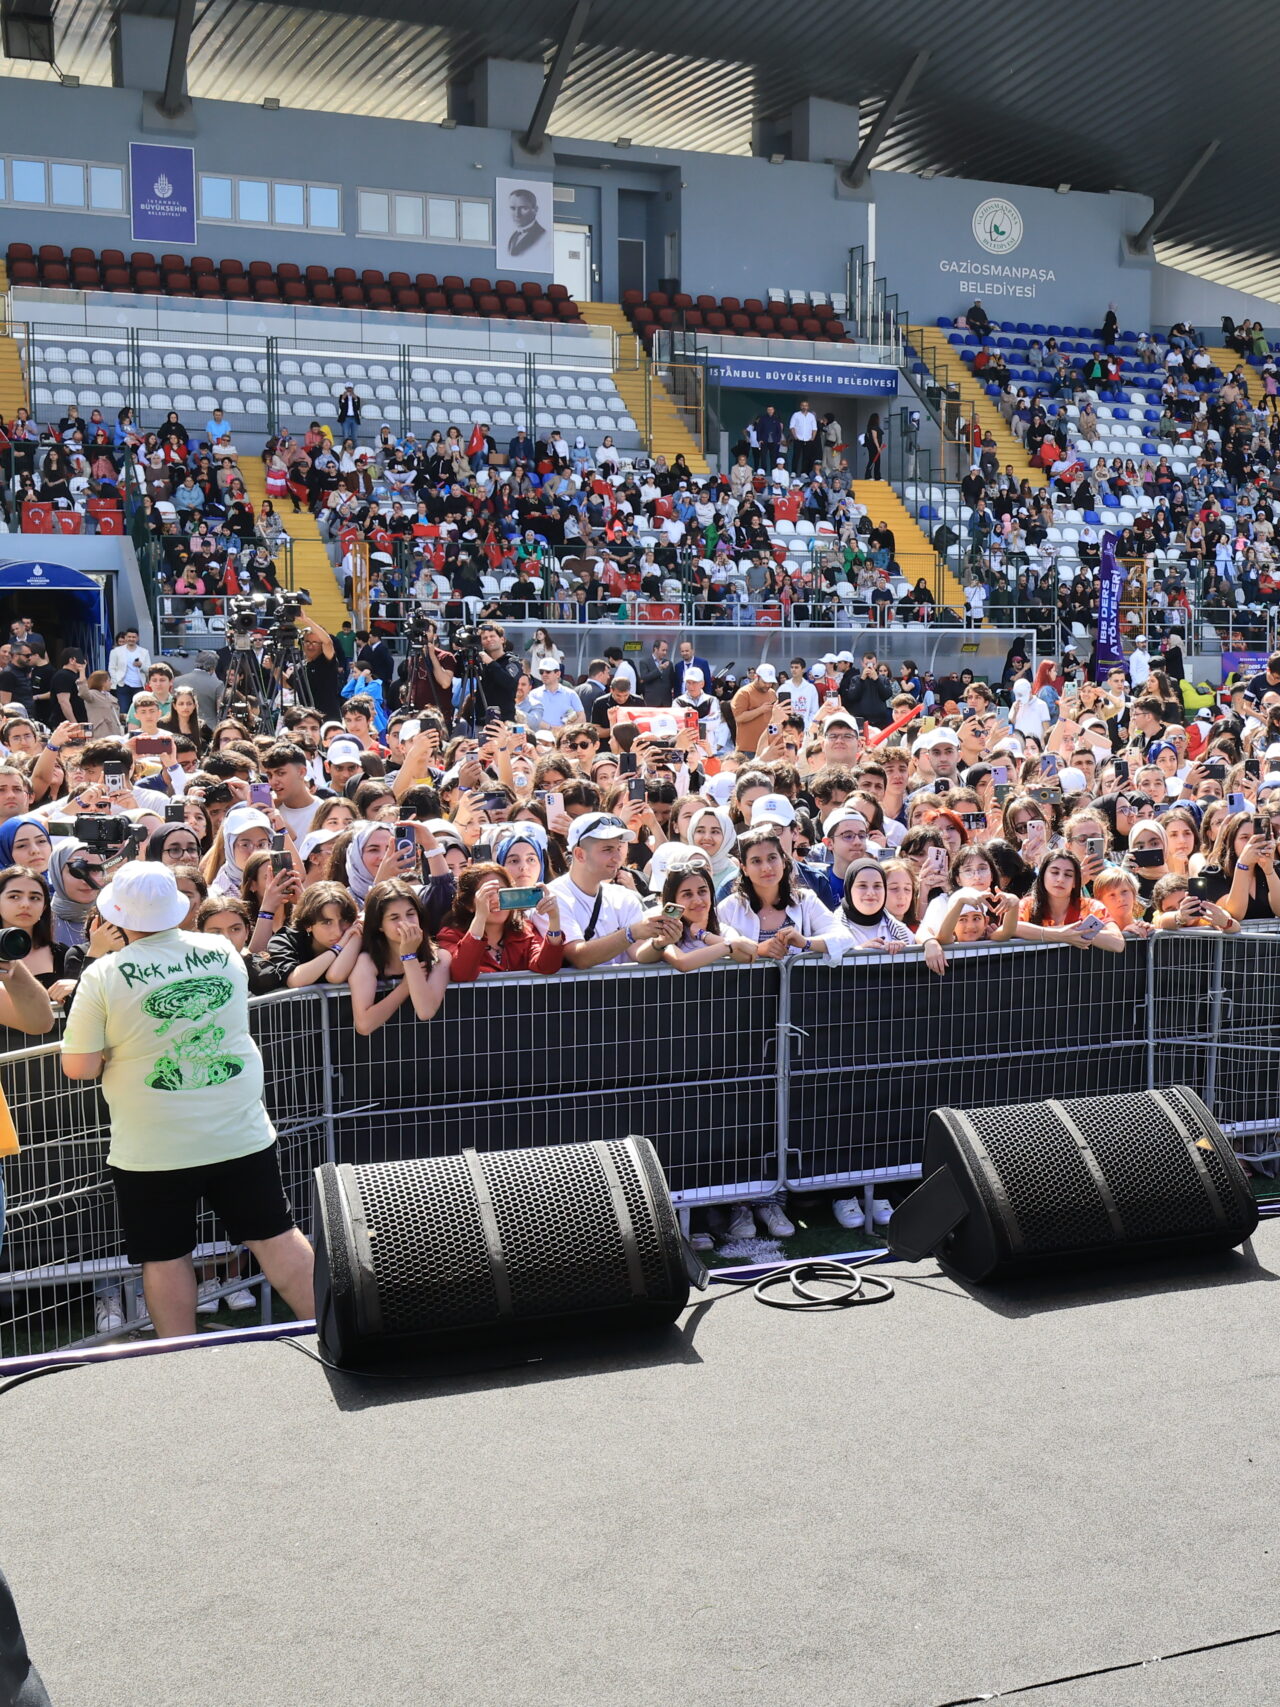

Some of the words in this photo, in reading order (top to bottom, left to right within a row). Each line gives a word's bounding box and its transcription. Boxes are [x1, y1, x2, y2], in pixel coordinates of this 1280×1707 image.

[140, 203, 188, 213] BÜYÜKŞEHİR
[939, 260, 1056, 283] GAZİOSMANPAŞA
[959, 281, 1036, 298] BELEDİYESİ
[765, 371, 833, 384] BÜYÜKŞEHİR
[837, 375, 896, 388] BELEDİYESİ
[1101, 580, 1110, 618] DERS
[1108, 569, 1121, 656] ATÖLYELERİ
[103, 855, 123, 869] RONIN
[118, 962, 166, 989] Rick
